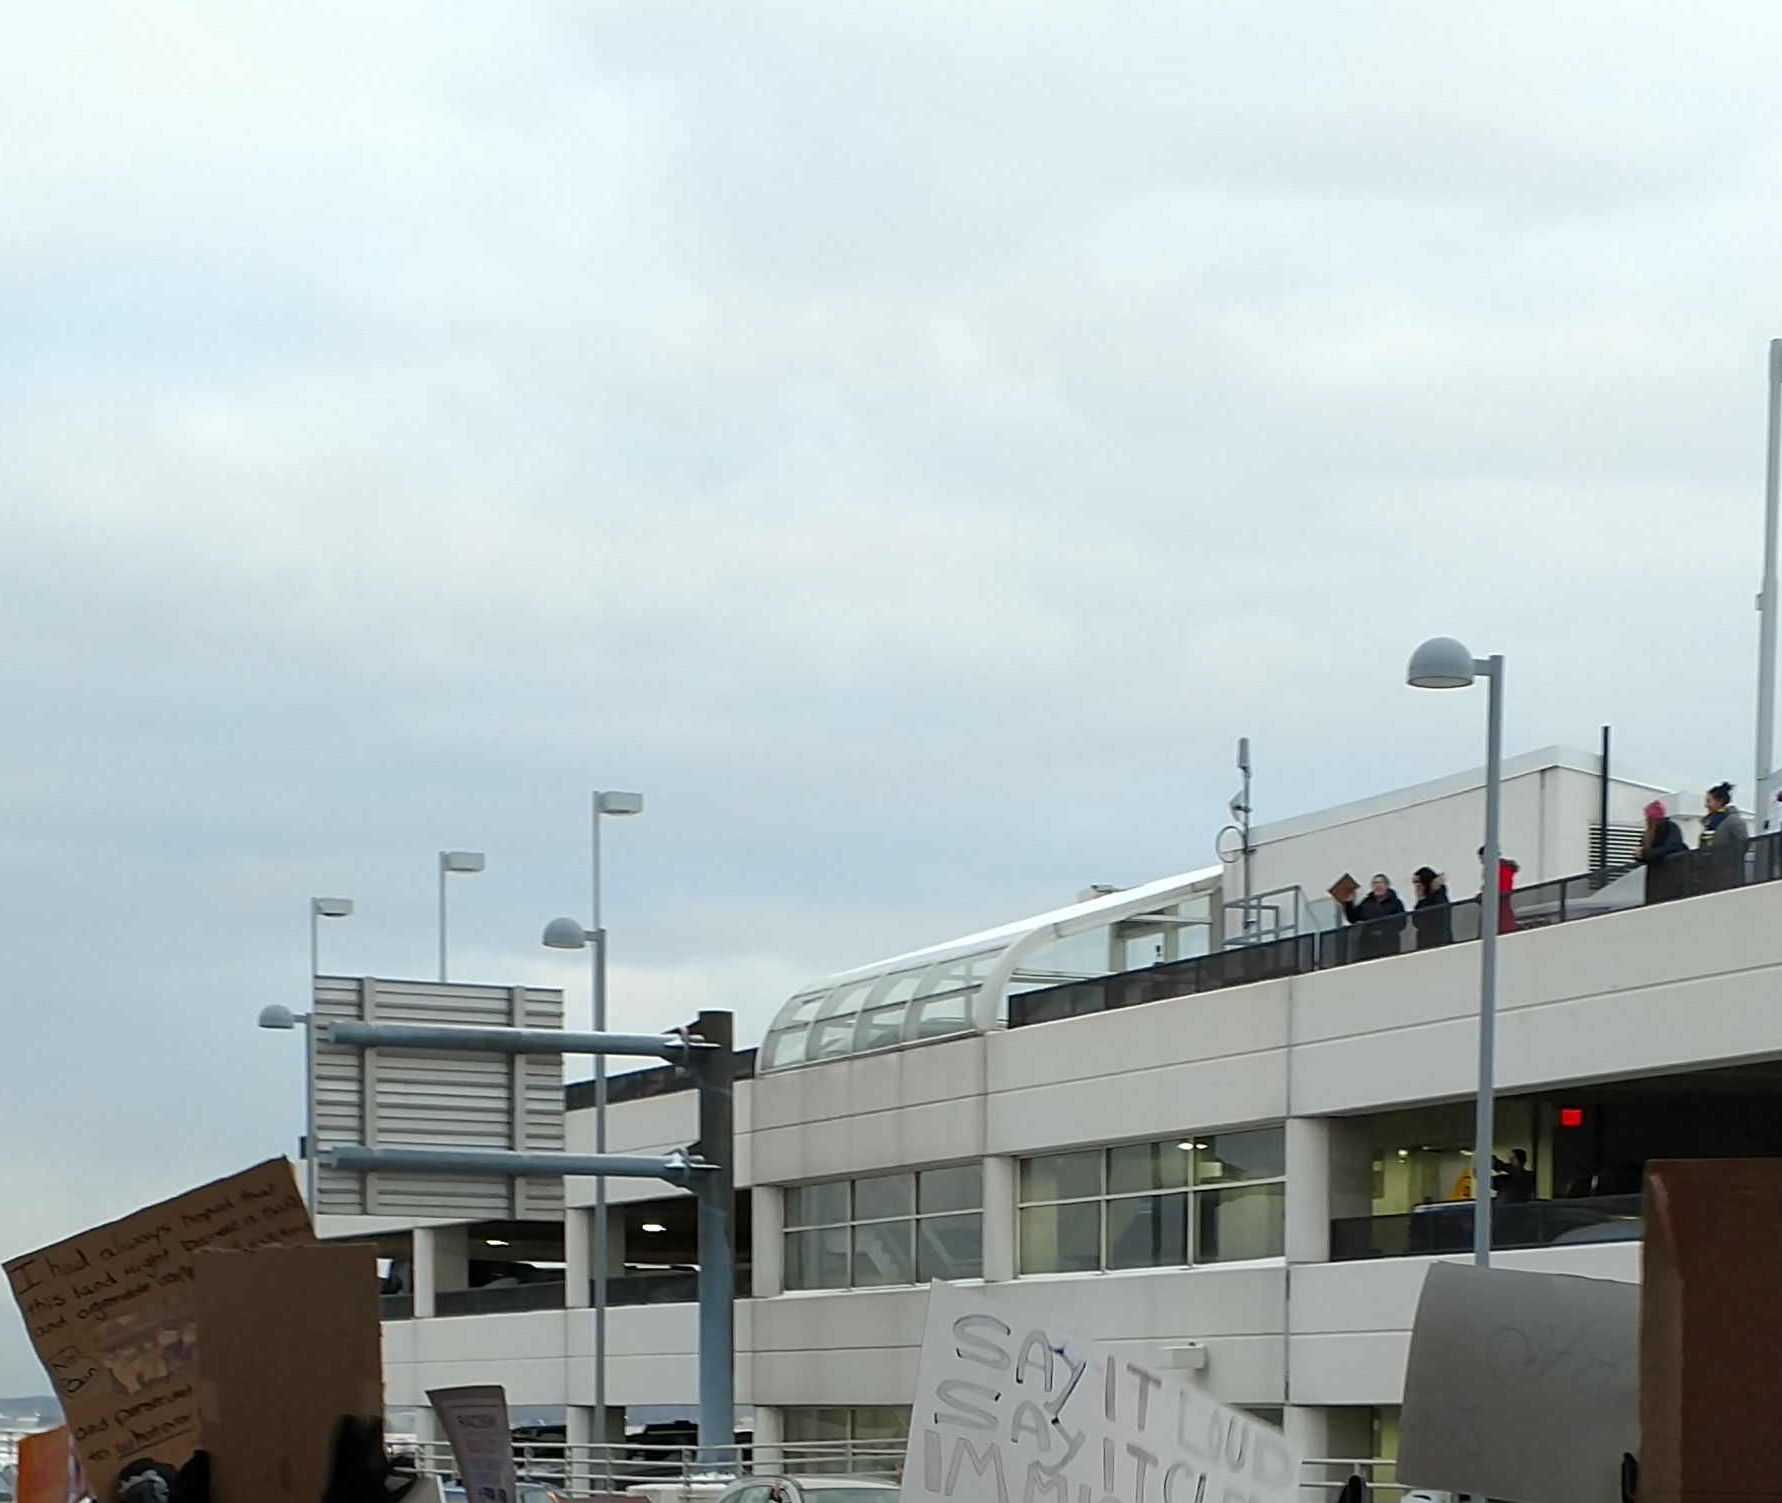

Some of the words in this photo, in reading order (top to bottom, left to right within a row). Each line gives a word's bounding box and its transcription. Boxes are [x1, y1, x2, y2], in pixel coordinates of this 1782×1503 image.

[10, 1259, 44, 1295] I
[45, 1248, 90, 1278] had
[27, 1295, 66, 1315] this
[36, 1314, 67, 1337] and
[952, 1314, 1086, 1413] SAY
[1105, 1355, 1162, 1432] IT
[1177, 1388, 1294, 1490] LOUD
[76, 1417, 109, 1442] and
[934, 1379, 1086, 1476] SAY
